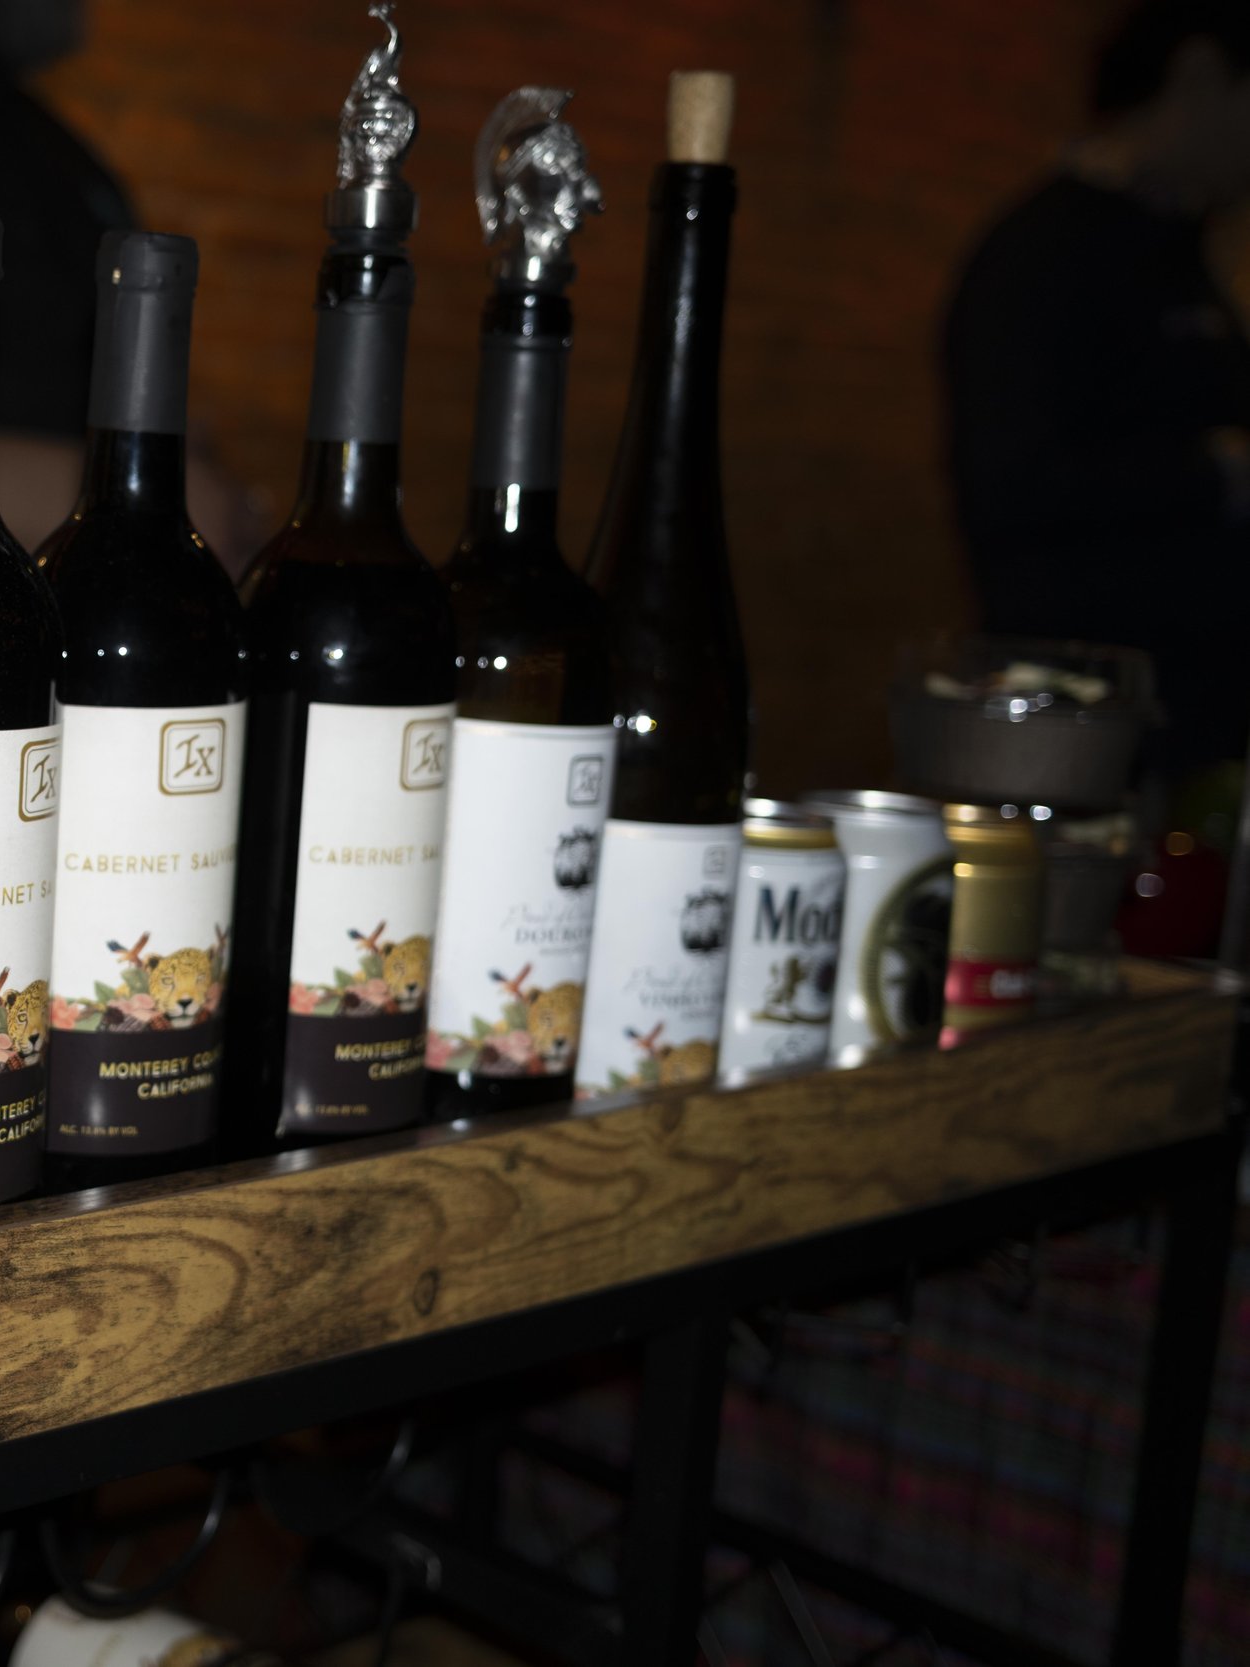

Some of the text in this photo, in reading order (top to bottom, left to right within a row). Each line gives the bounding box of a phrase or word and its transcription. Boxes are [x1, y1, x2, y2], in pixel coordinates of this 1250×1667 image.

[64, 853, 181, 873] CABERNET
[308, 845, 414, 865] CABERNET
[99, 1056, 189, 1078] MONTEREY
